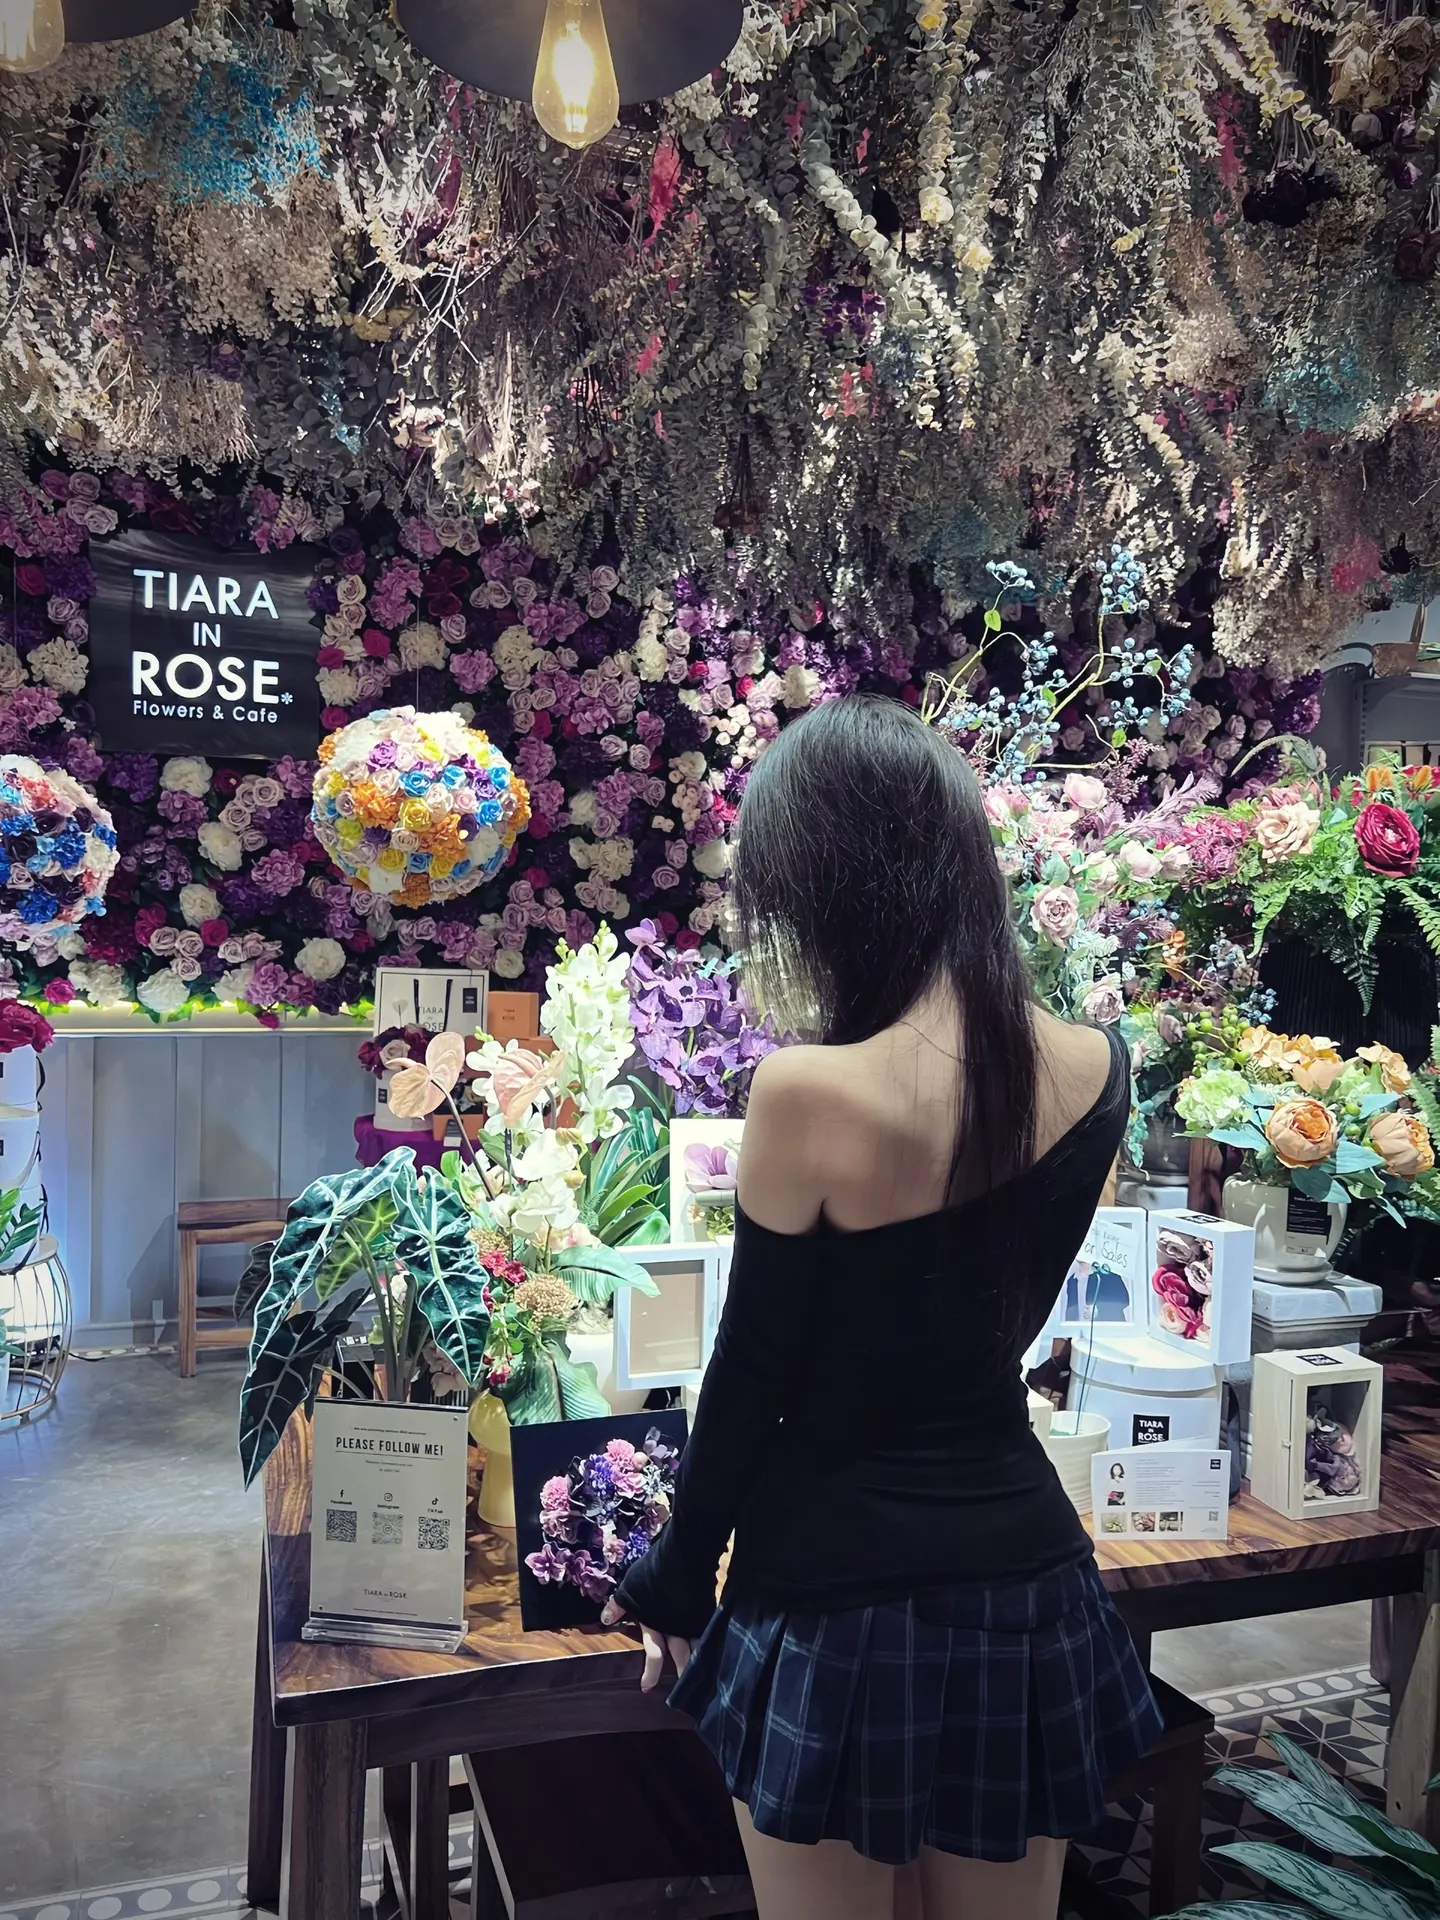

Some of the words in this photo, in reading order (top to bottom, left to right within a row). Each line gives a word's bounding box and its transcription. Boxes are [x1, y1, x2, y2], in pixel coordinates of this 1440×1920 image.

[133, 568, 279, 619] TIARA
[193, 621, 221, 648] IN
[132, 651, 279, 704] ROSE
[133, 700, 204, 719] Flowers
[212, 705, 224, 720] &
[232, 706, 278, 723] Cafe
[422, 1021, 444, 1031] OSE
[1101, 1240, 1127, 1268] Sales
[1139, 1419, 1164, 1428] TIARA
[336, 1437, 374, 1450] PLEASE
[379, 1440, 420, 1454] FOLLOW
[424, 1444, 444, 1456] ME!
[364, 1588, 383, 1597] TIARA
